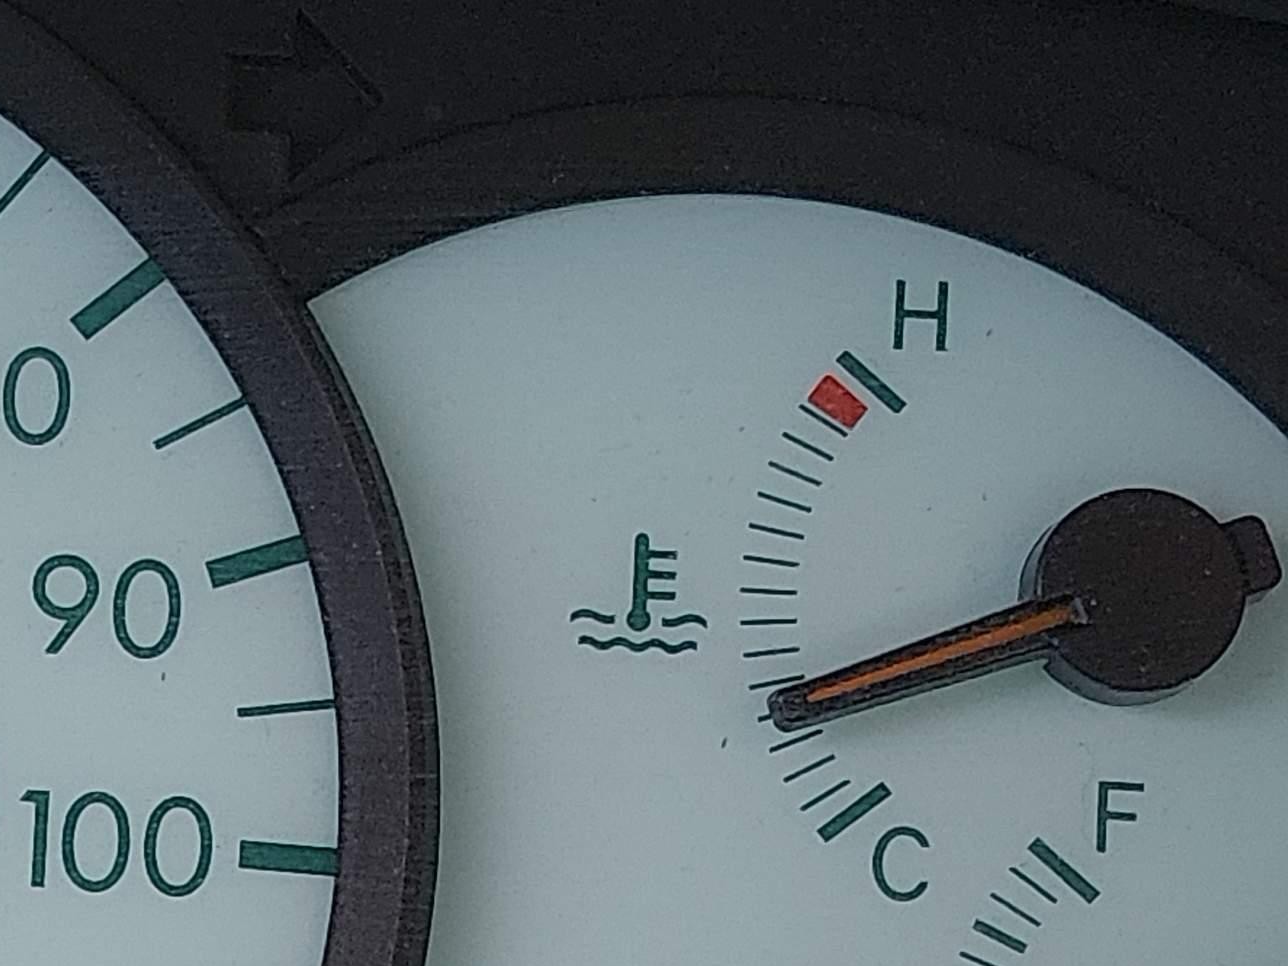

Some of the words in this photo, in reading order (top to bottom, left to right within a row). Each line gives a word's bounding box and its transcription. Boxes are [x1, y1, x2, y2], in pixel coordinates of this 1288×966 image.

[893, 280, 948, 351] H
[33, 554, 181, 659] 90
[20, 790, 212, 897] 100
[1097, 781, 1144, 853] F
[873, 827, 929, 901] C
